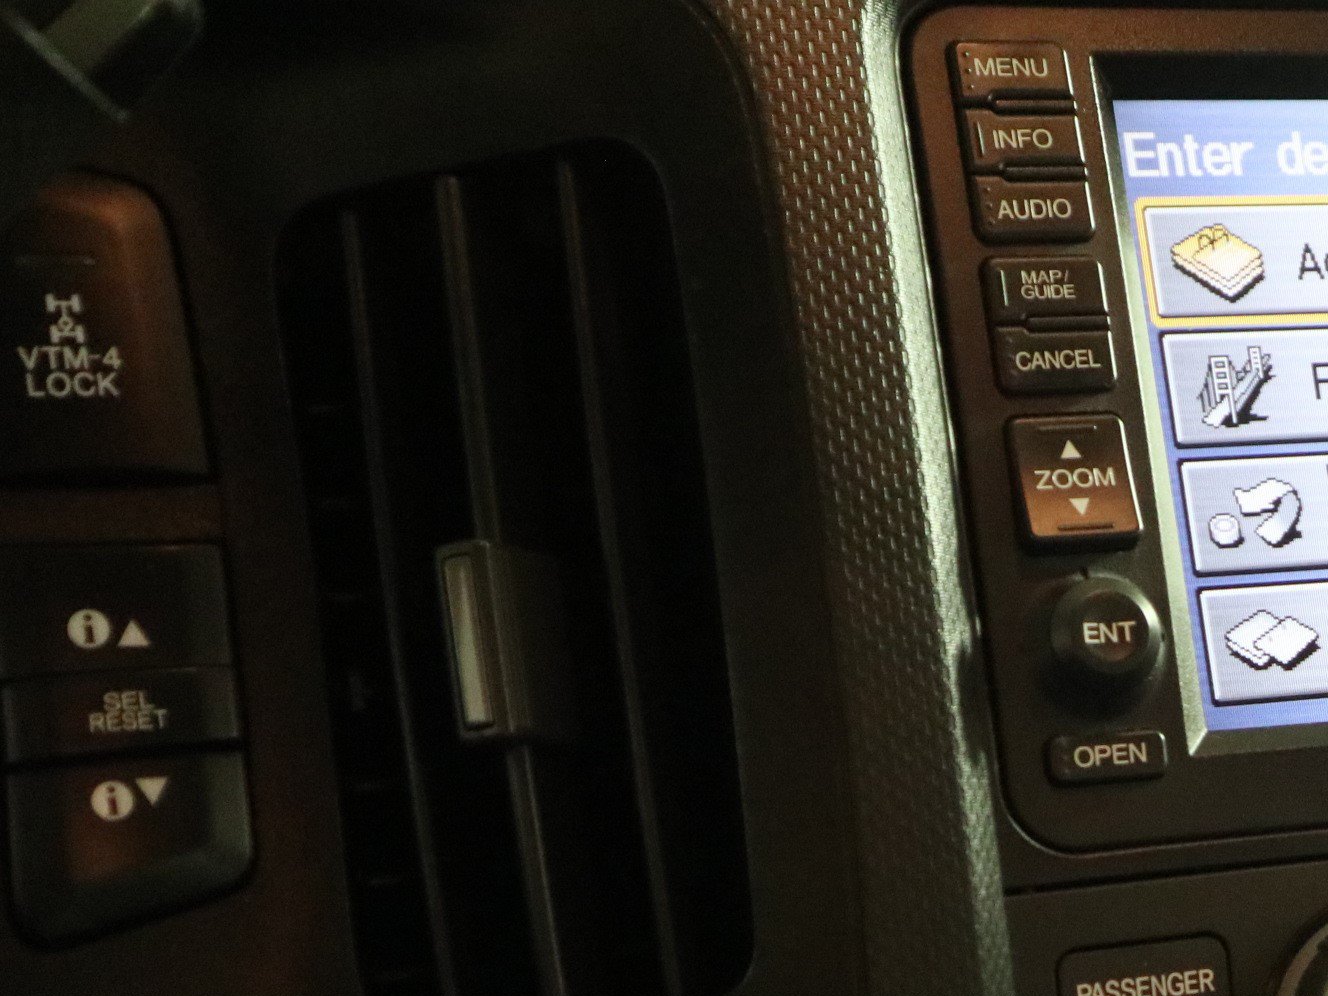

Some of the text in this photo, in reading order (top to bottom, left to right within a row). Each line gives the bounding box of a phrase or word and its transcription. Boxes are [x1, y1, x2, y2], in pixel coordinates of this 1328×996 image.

[975, 57, 1048, 77] MENU
[993, 128, 1053, 149] INFO
[1123, 132, 1252, 178] Enter
[998, 199, 1072, 220] AUDIO
[1020, 270, 1068, 285] MAP/
[1020, 282, 1076, 299] GUIDE
[16, 346, 123, 370] VTM-4
[1015, 348, 1101, 371] CANCEL
[25, 371, 120, 397] LOCK
[1034, 468, 1116, 491] ZOOM
[1082, 620, 1135, 644] ENT
[103, 690, 155, 710] SEL
[89, 708, 168, 732] RESET
[1073, 743, 1148, 767] OPEN
